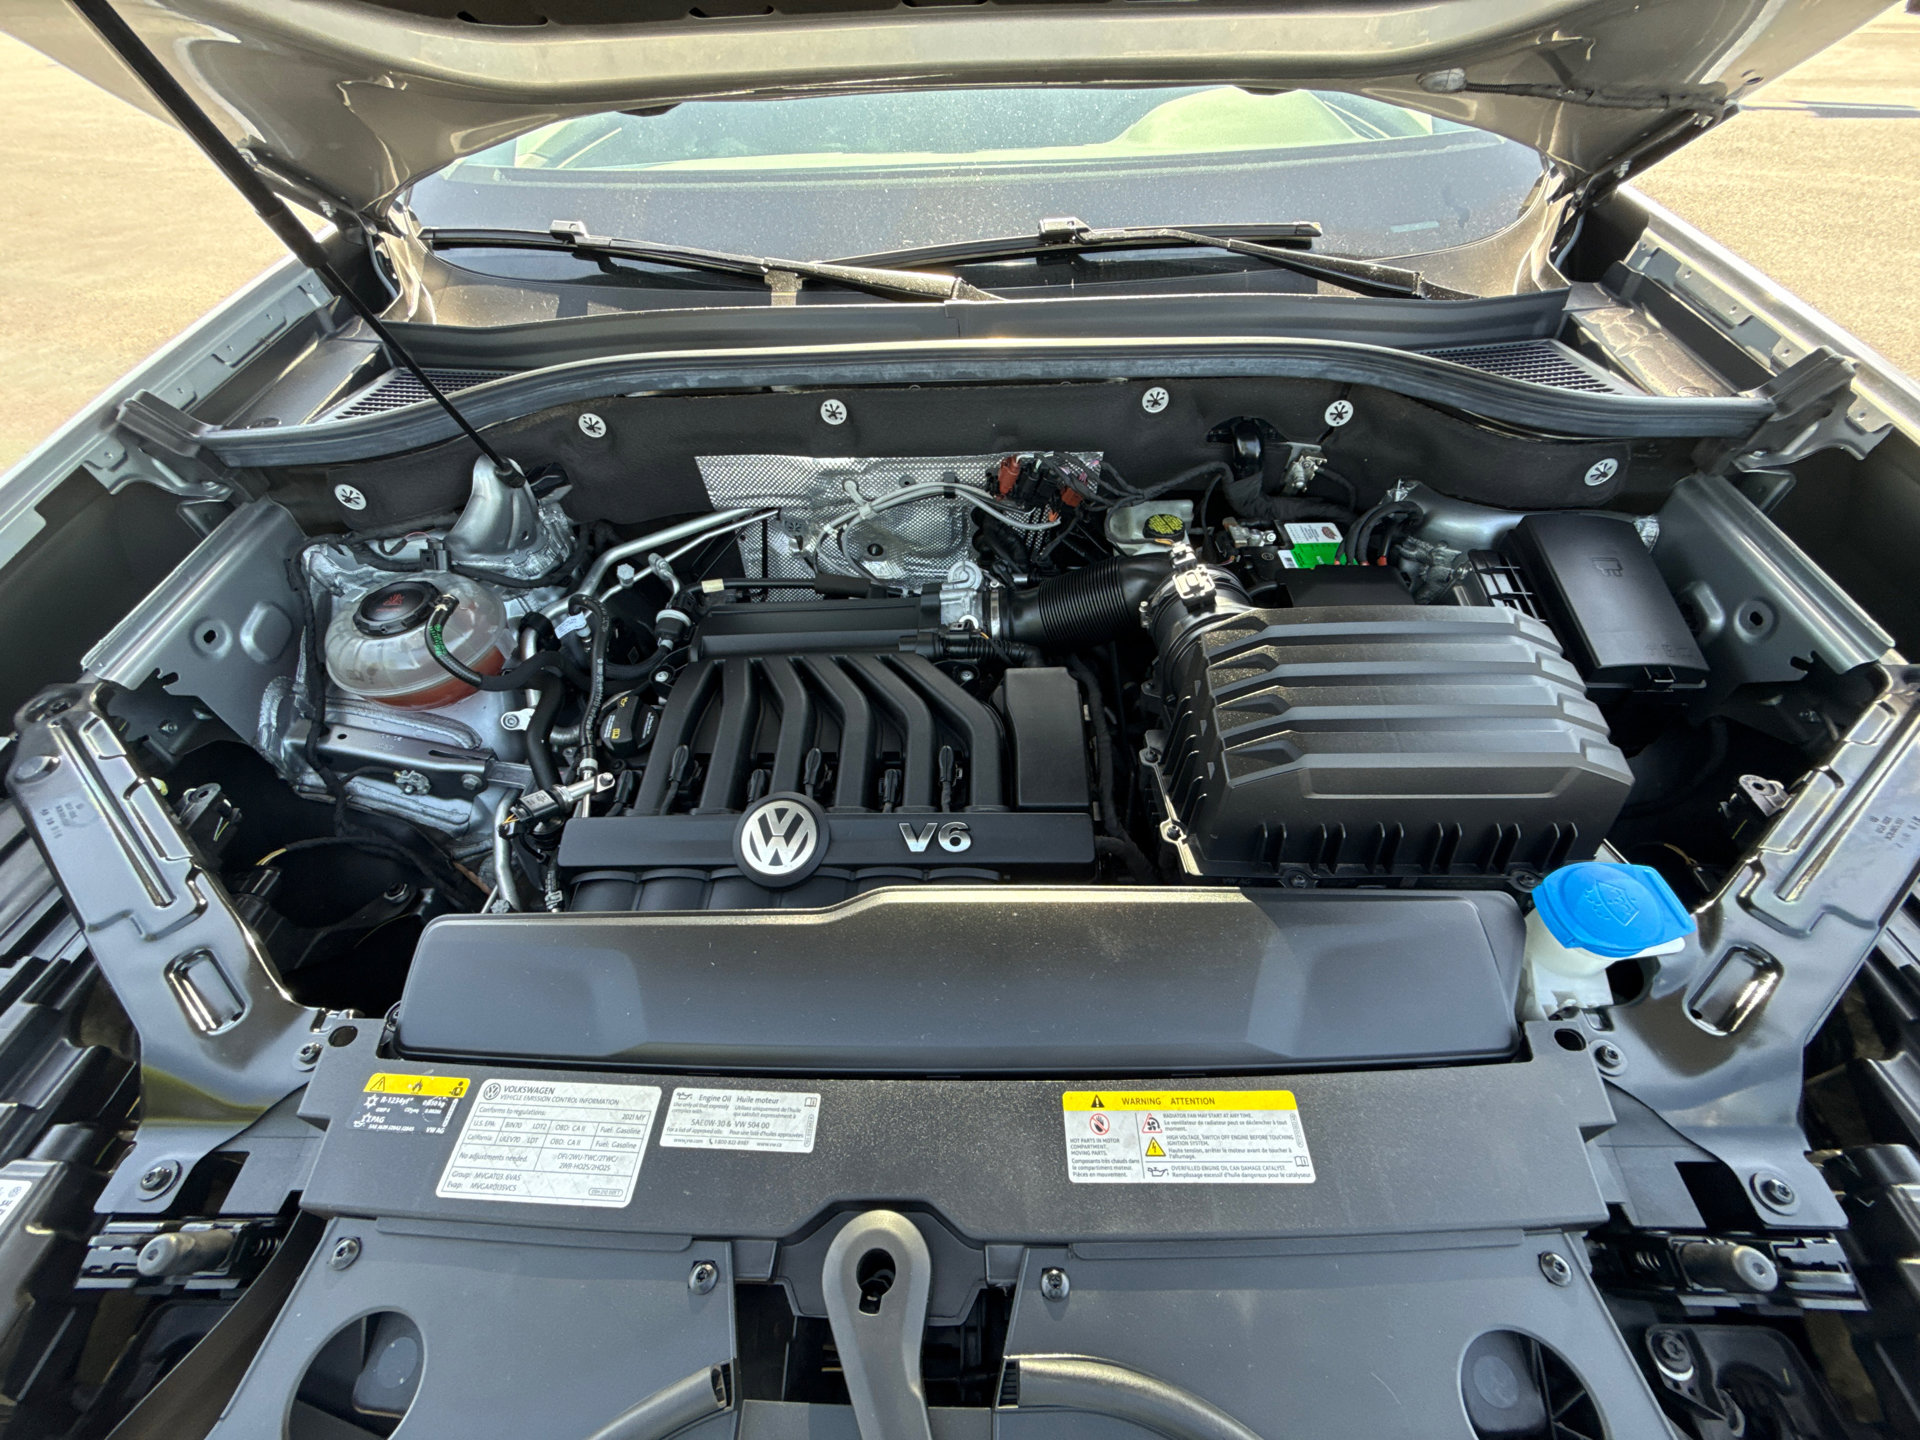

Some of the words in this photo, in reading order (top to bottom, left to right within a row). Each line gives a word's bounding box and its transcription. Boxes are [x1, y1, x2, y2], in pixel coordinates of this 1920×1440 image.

[741, 800, 817, 875] VW
[898, 821, 972, 853] V6
[504, 1086, 555, 1095] VOLKSWAGEN
[699, 1095, 721, 1104] Engine
[1121, 1097, 1162, 1106] WARNING
[1170, 1098, 1216, 1106] ATTENTION
[469, 1153, 504, 1162] adjustments
